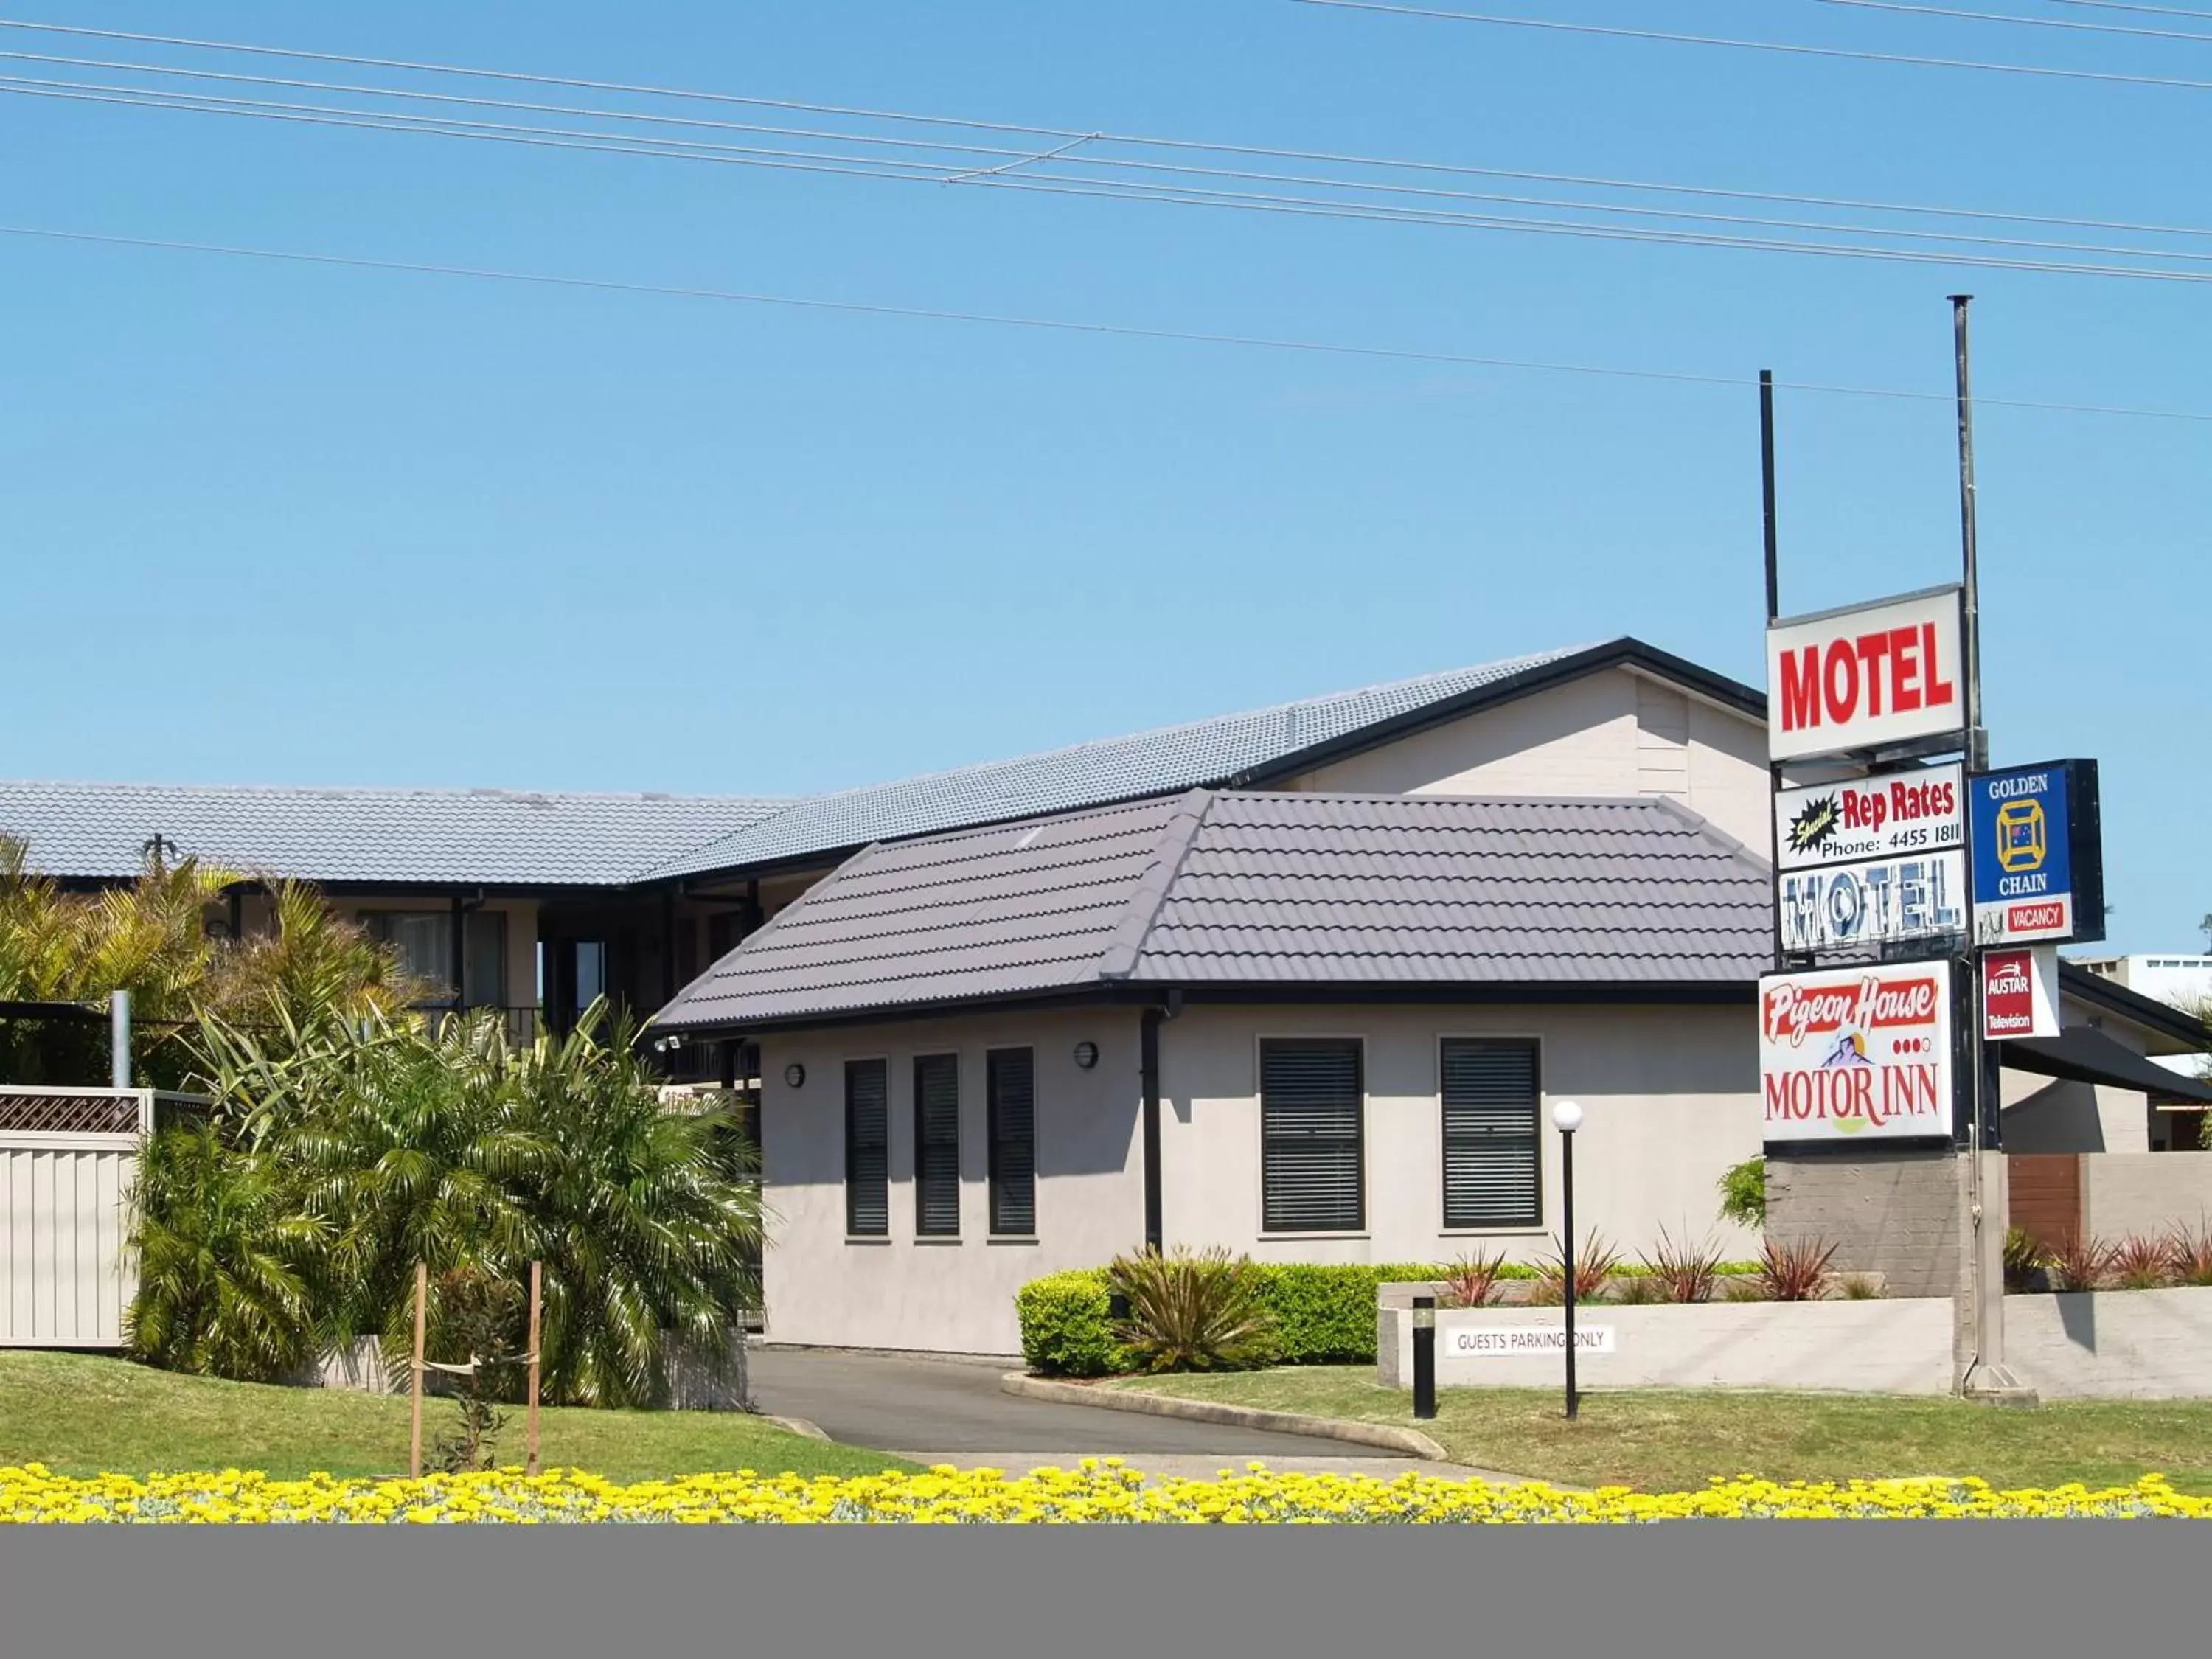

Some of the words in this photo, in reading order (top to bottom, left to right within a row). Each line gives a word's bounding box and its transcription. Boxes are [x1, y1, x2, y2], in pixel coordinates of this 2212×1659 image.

[1779, 620, 1954, 733] MOTEL
[1989, 773, 2048, 799] GOLDEN
[1842, 789, 1887, 833] Rep
[1891, 779, 1954, 822] Rates
[1822, 839, 1880, 858] Phone:
[1889, 828, 1927, 848] 4455
[1935, 824, 1960, 842] 1811
[1999, 873, 2047, 896] CHAIN
[1784, 859, 1961, 942] MOTEL
[2012, 907, 2059, 928] VACANCY
[1988, 975, 2029, 995] AUSTAR
[1768, 982, 1854, 1048] Pigeon
[1851, 975, 1938, 1035] House
[1988, 1012, 2030, 1029] Television
[1764, 1066, 1888, 1127] MOTOR
[1880, 1062, 1938, 1116] INN
[1458, 1333, 1506, 1349] GUESTS
[1512, 1332, 1565, 1349] PARKING
